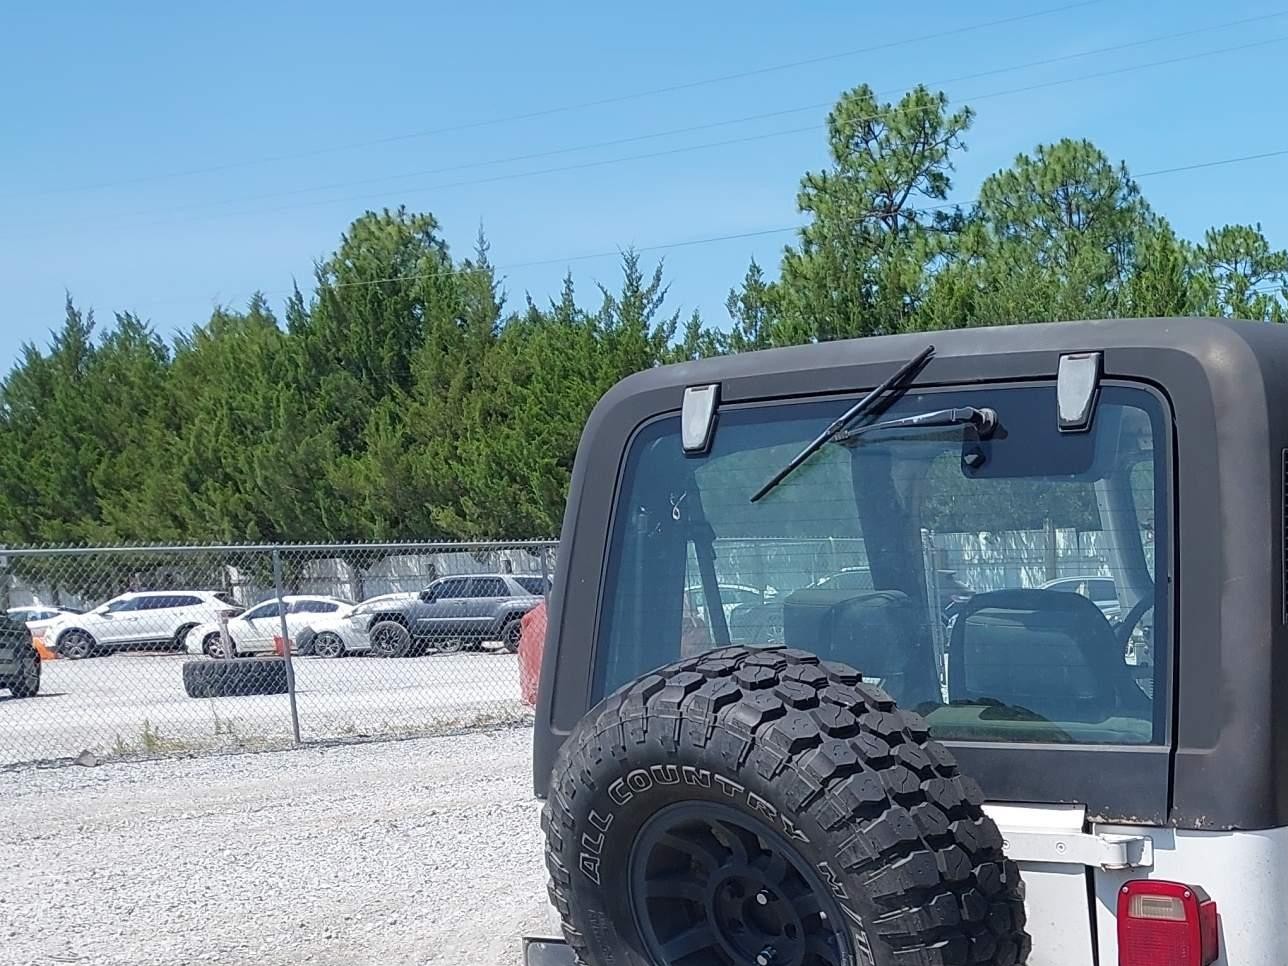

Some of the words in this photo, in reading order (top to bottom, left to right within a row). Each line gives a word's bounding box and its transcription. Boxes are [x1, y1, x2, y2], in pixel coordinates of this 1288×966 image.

[578, 808, 614, 884] ALL
[607, 765, 812, 844] COUNTRY
[816, 861, 876, 966] M/T
